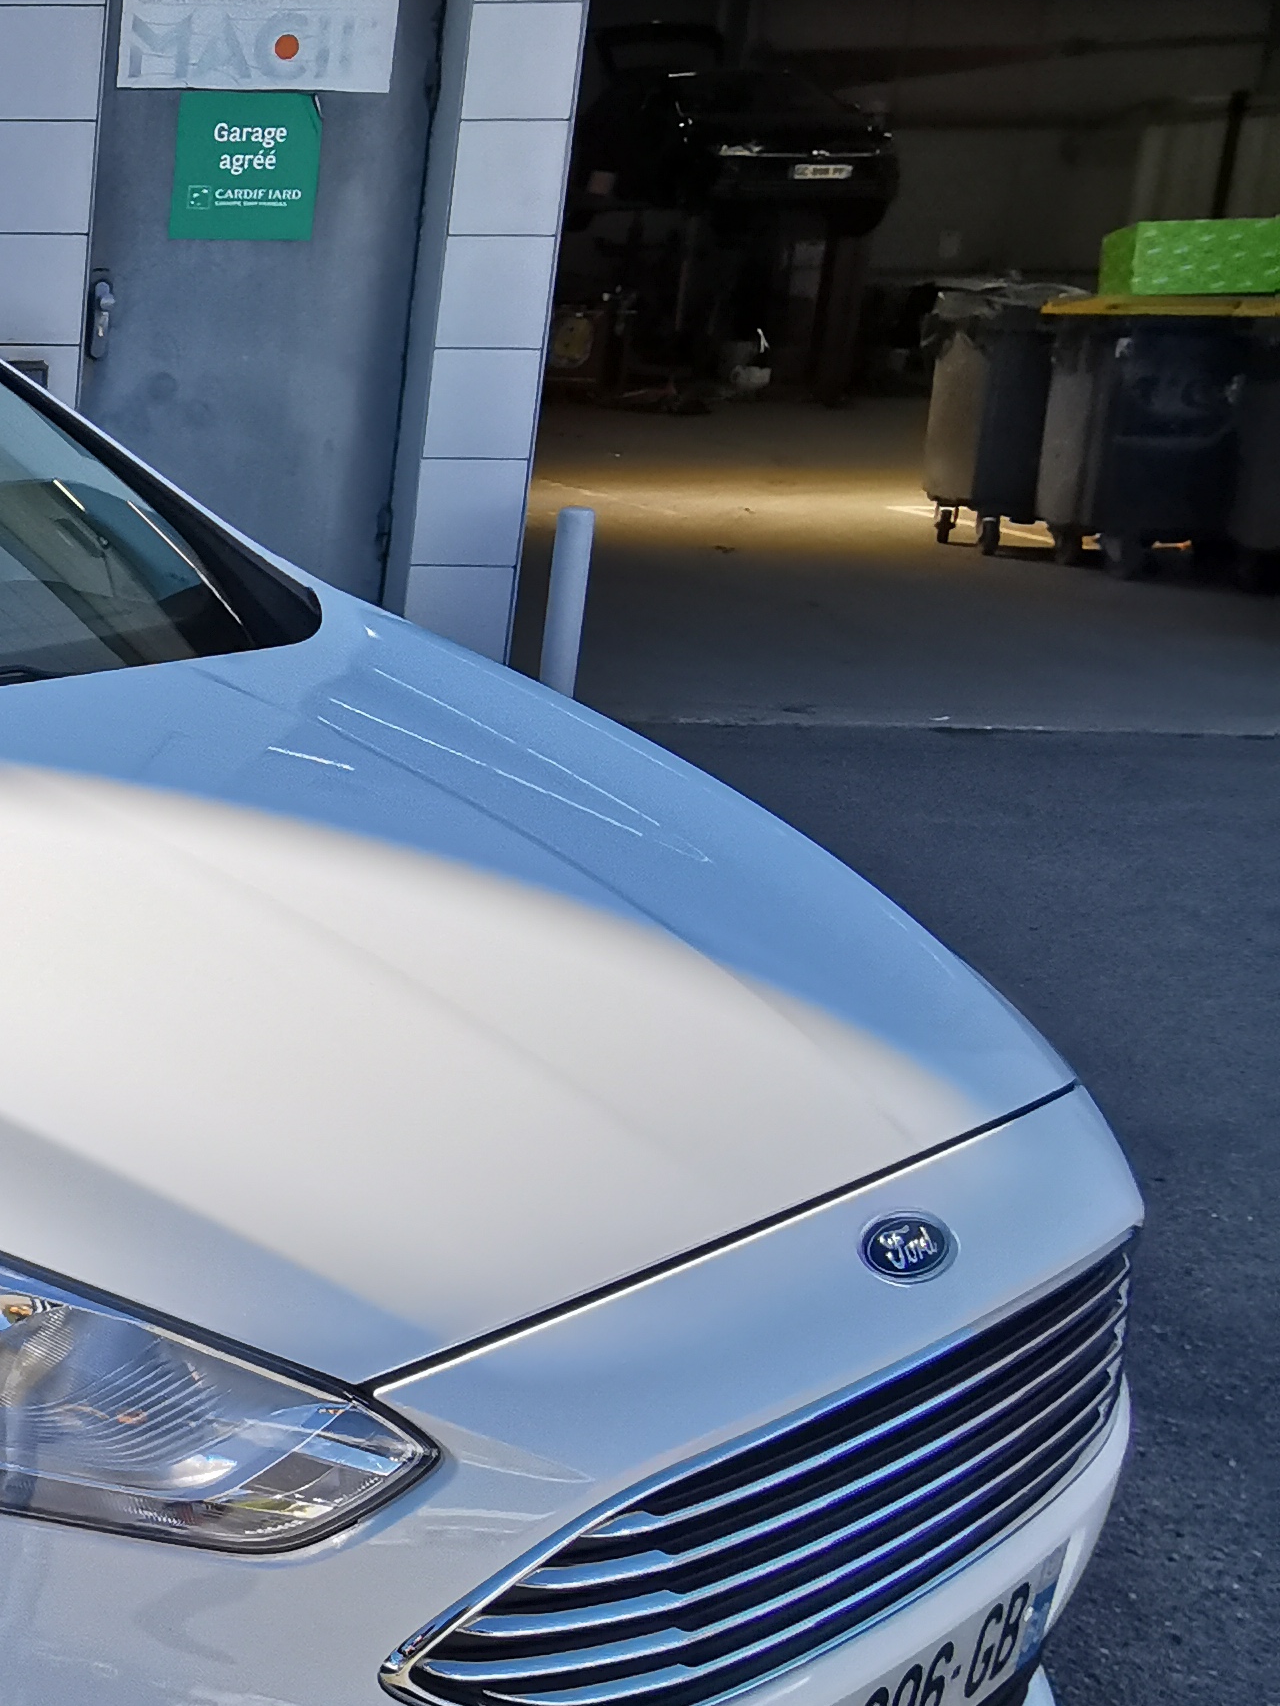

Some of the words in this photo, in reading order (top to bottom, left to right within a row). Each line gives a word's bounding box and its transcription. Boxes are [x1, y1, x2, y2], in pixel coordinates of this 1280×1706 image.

[213, 122, 288, 148] Garage
[219, 149, 277, 176] agréé
[214, 188, 267, 200] CARDIF
[877, 1224, 938, 1270] Ford
